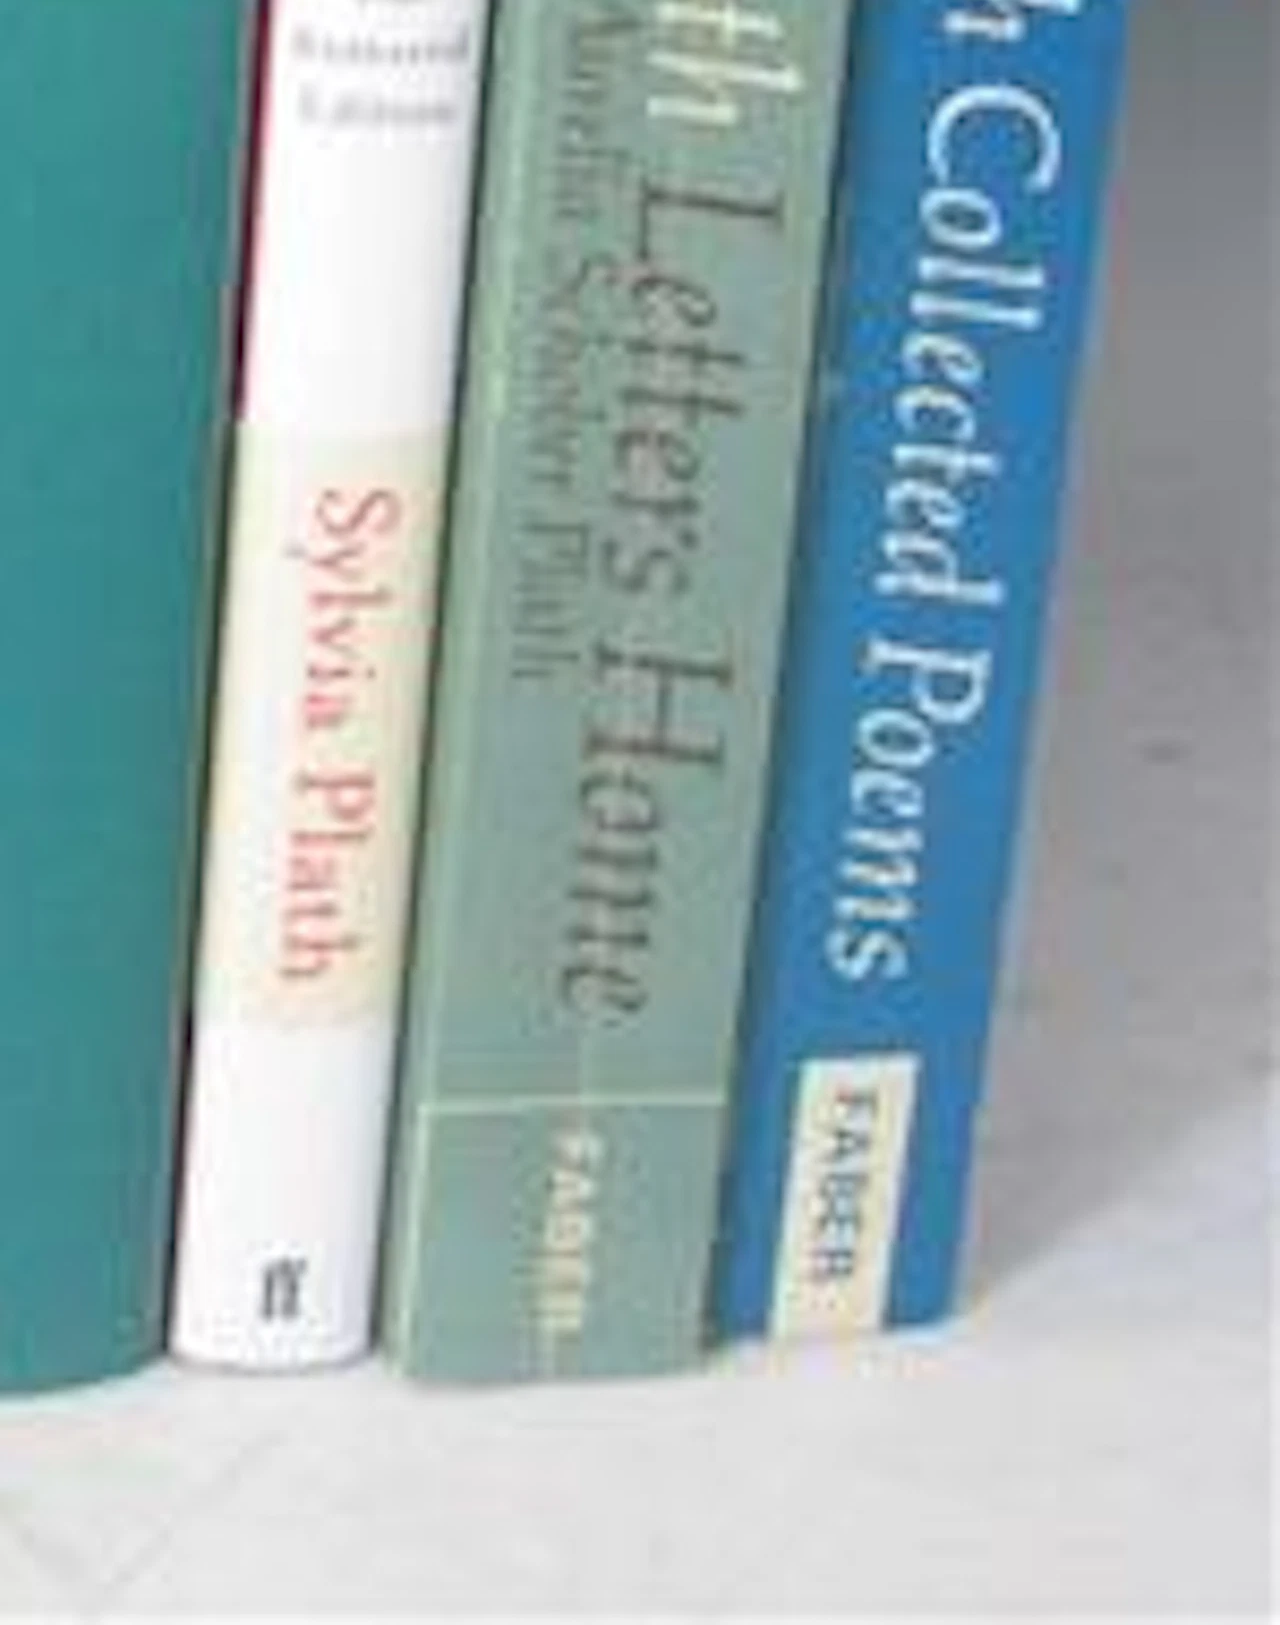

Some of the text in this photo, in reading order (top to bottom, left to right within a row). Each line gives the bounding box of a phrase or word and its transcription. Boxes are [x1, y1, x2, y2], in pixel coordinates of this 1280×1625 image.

[597, 176, 790, 596] Letters
[872, 82, 1065, 609] Collected
[278, 482, 404, 987] Sylvia Plath
[555, 636, 738, 1026] Home
[824, 634, 995, 986] Poems
[533, 1129, 608, 1339] FABER
[806, 1086, 882, 1290] FABER
